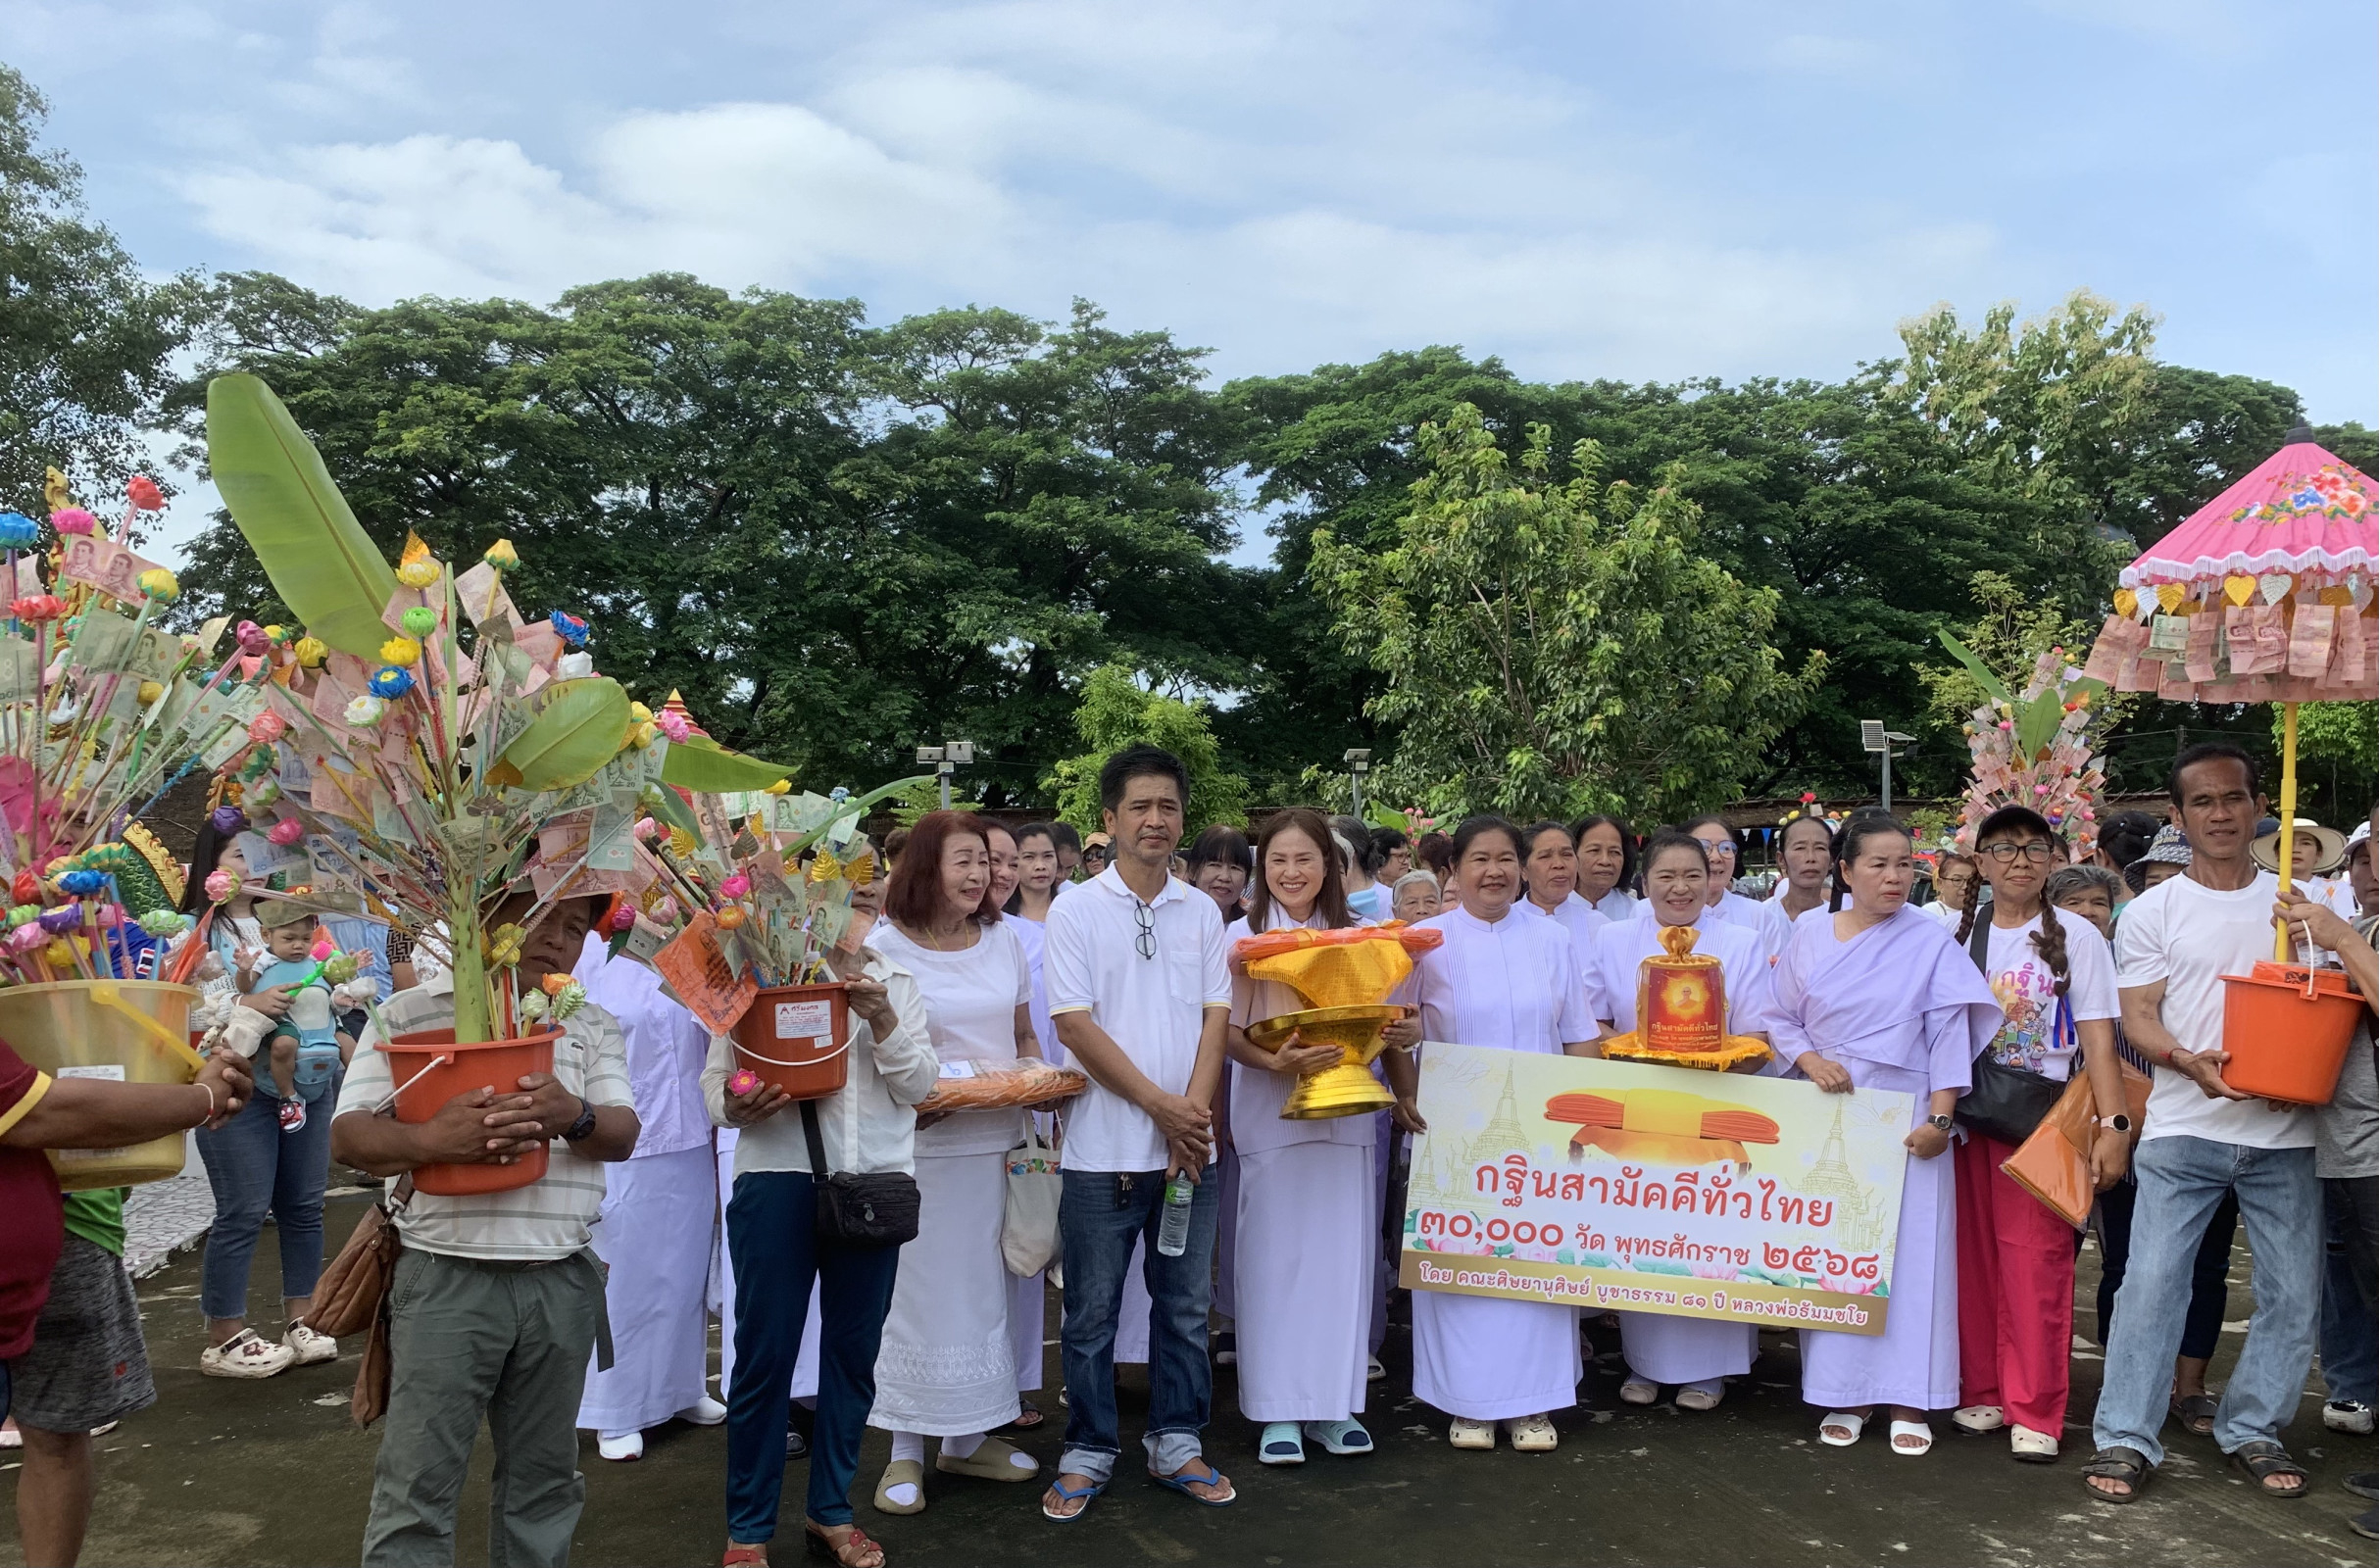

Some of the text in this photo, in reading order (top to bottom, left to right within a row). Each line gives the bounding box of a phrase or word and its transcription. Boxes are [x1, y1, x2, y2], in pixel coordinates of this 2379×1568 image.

[184, 720, 196, 730] 20
[1476, 1154, 1833, 1227] กฐินสามัคคีทั่วไทย
[1420, 1211, 1880, 1280] ๓๐,๐๐๐ วัด พุทธศักราช ๒๕๖๘
[1421, 1262, 1866, 1324] โดย คณะศิษยานุศิษย์ บูชาธรรม ๘๑ ปี หลวงพ่อธัมมชโย
